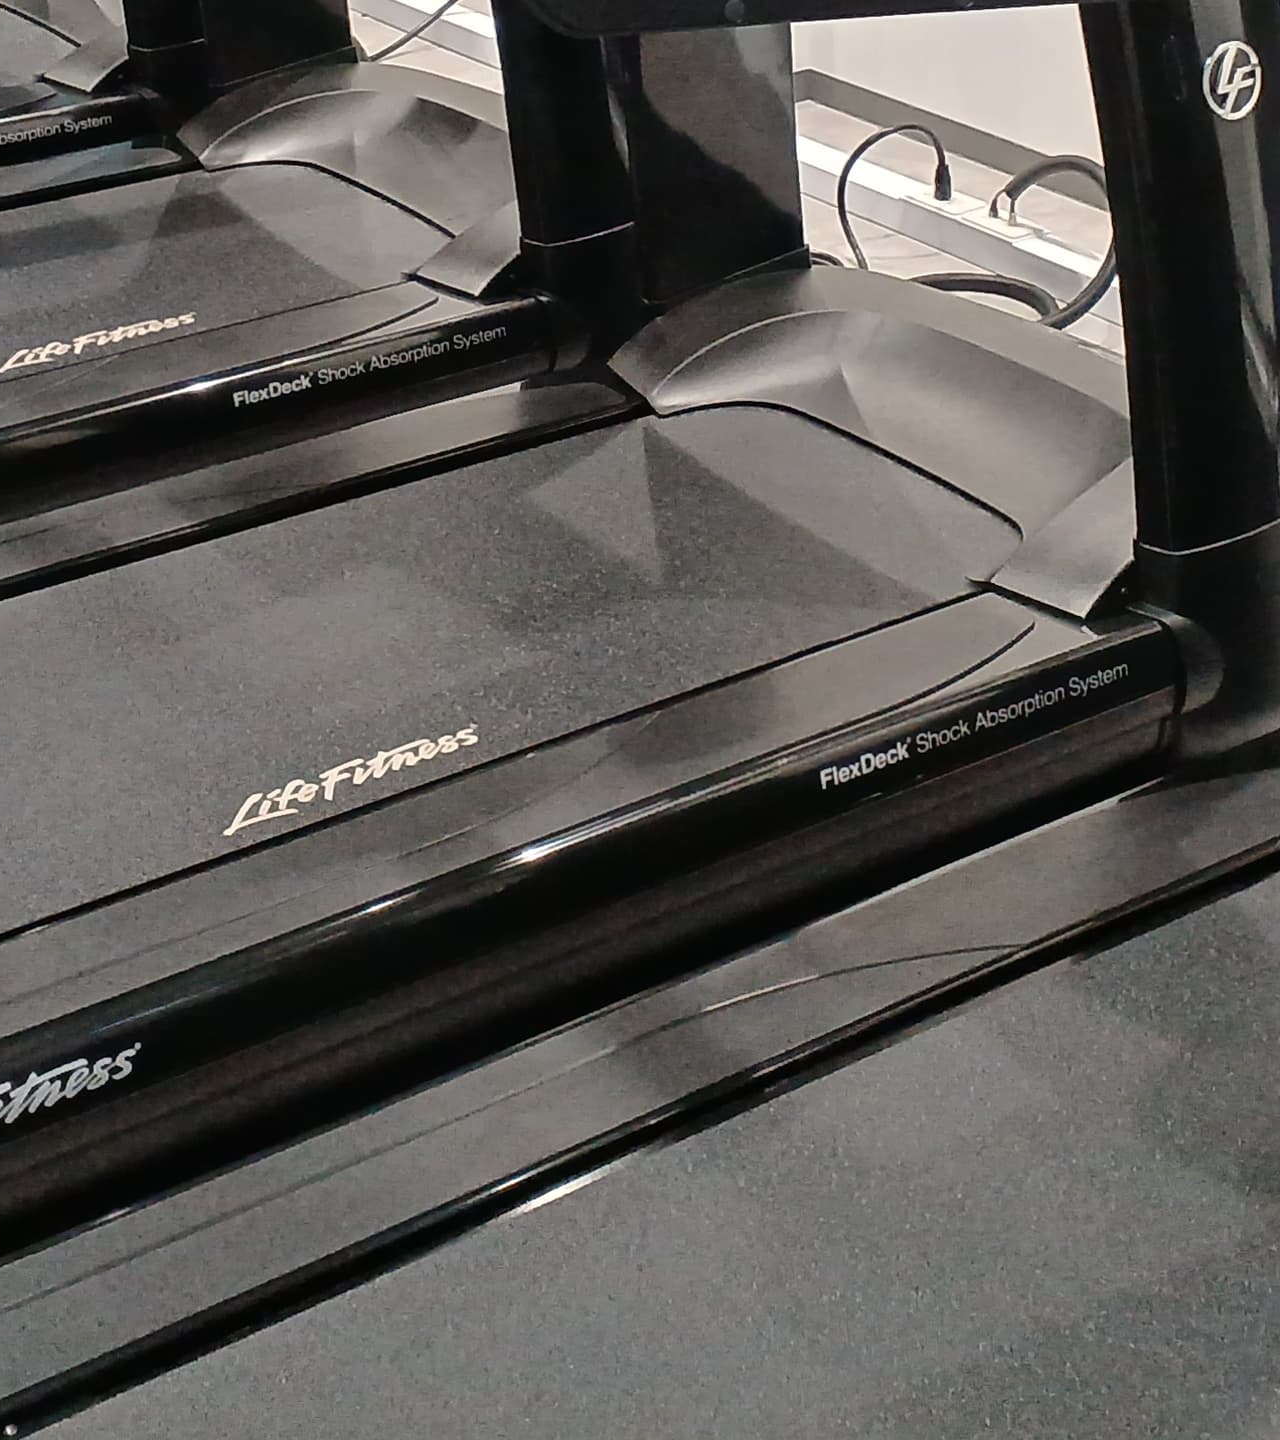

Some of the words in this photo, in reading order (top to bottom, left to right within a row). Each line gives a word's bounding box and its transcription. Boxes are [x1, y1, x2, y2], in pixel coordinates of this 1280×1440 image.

[63, 114, 113, 135] System
[317, 362, 366, 385] Shock
[370, 339, 450, 371] Absorption
[453, 325, 507, 351] System
[916, 720, 971, 754] Shock
[975, 685, 1065, 732] Absorption
[1068, 663, 1129, 697] System
[223, 779, 319, 836] Life
[319, 724, 479, 801] Fitness
